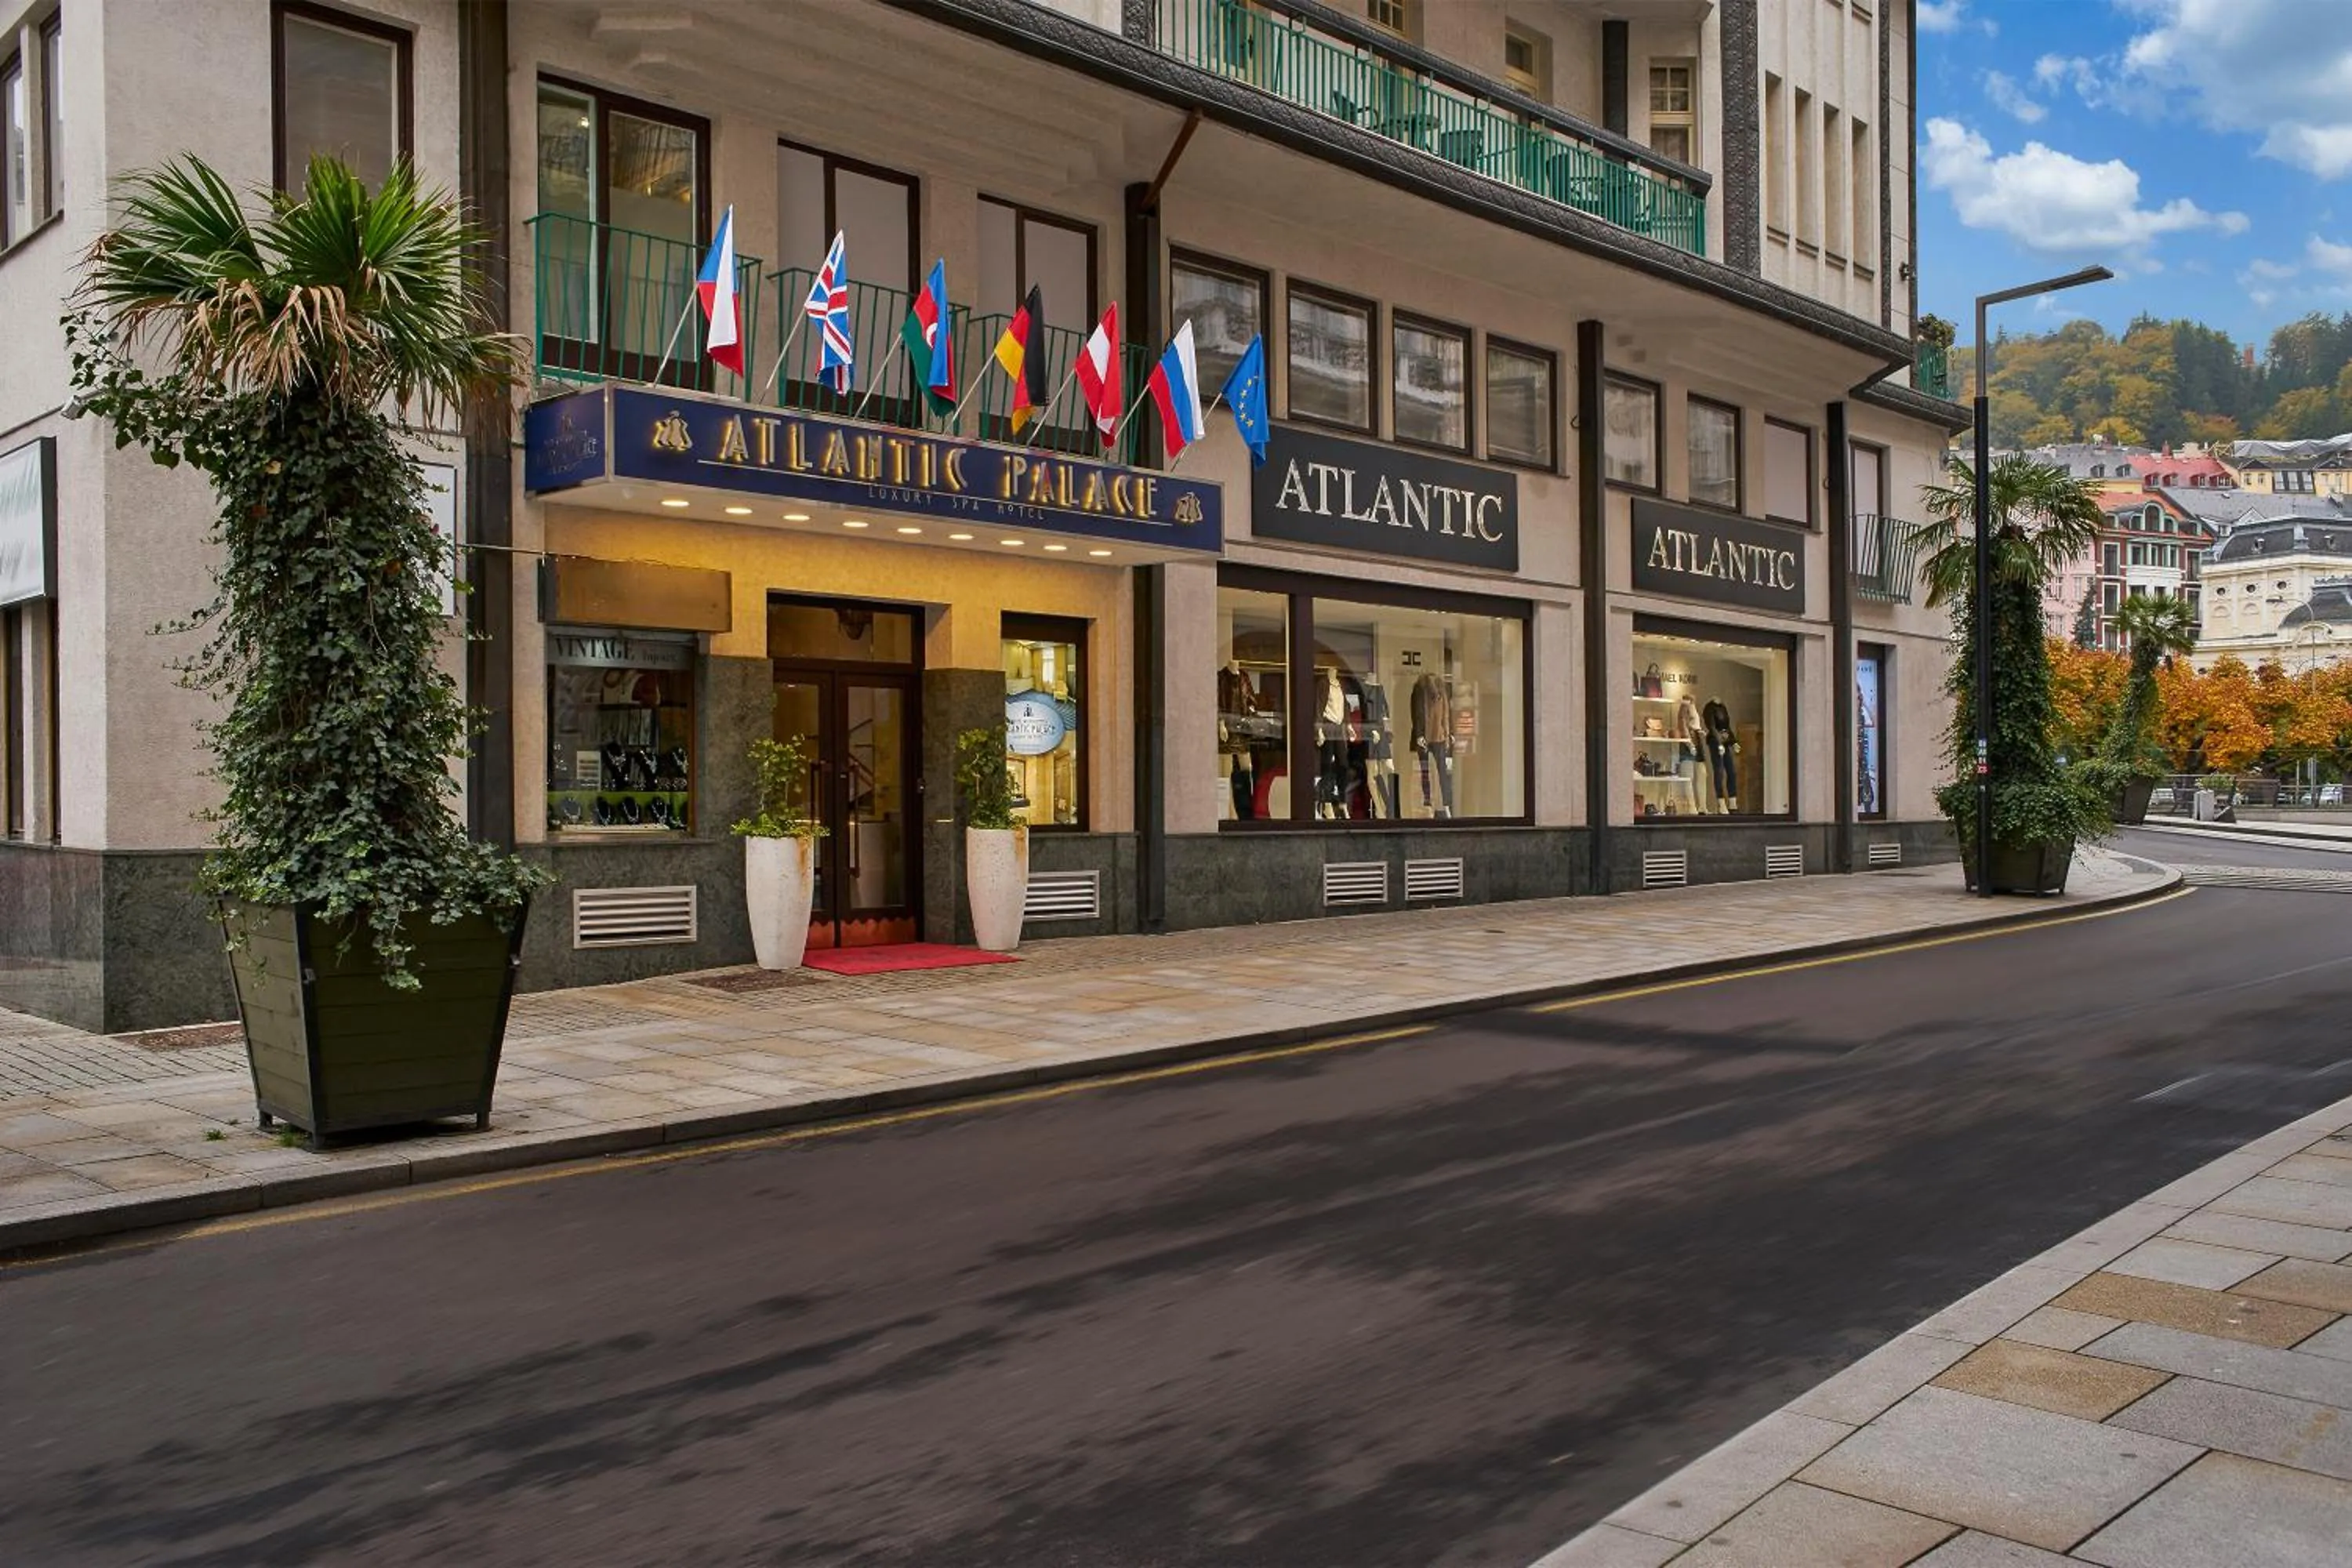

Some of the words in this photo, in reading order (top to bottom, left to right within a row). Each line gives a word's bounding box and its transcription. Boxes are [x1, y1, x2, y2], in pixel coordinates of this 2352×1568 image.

[718, 413, 969, 492] ATLANTIC
[1001, 455, 1159, 519] PALACE
[868, 486, 932, 506] LUXURY
[952, 497, 980, 510] SPA
[1275, 457, 1504, 543] ATLANTIC
[1647, 526, 1795, 590] ATLANTIC
[554, 637, 636, 661] VINTAGE
